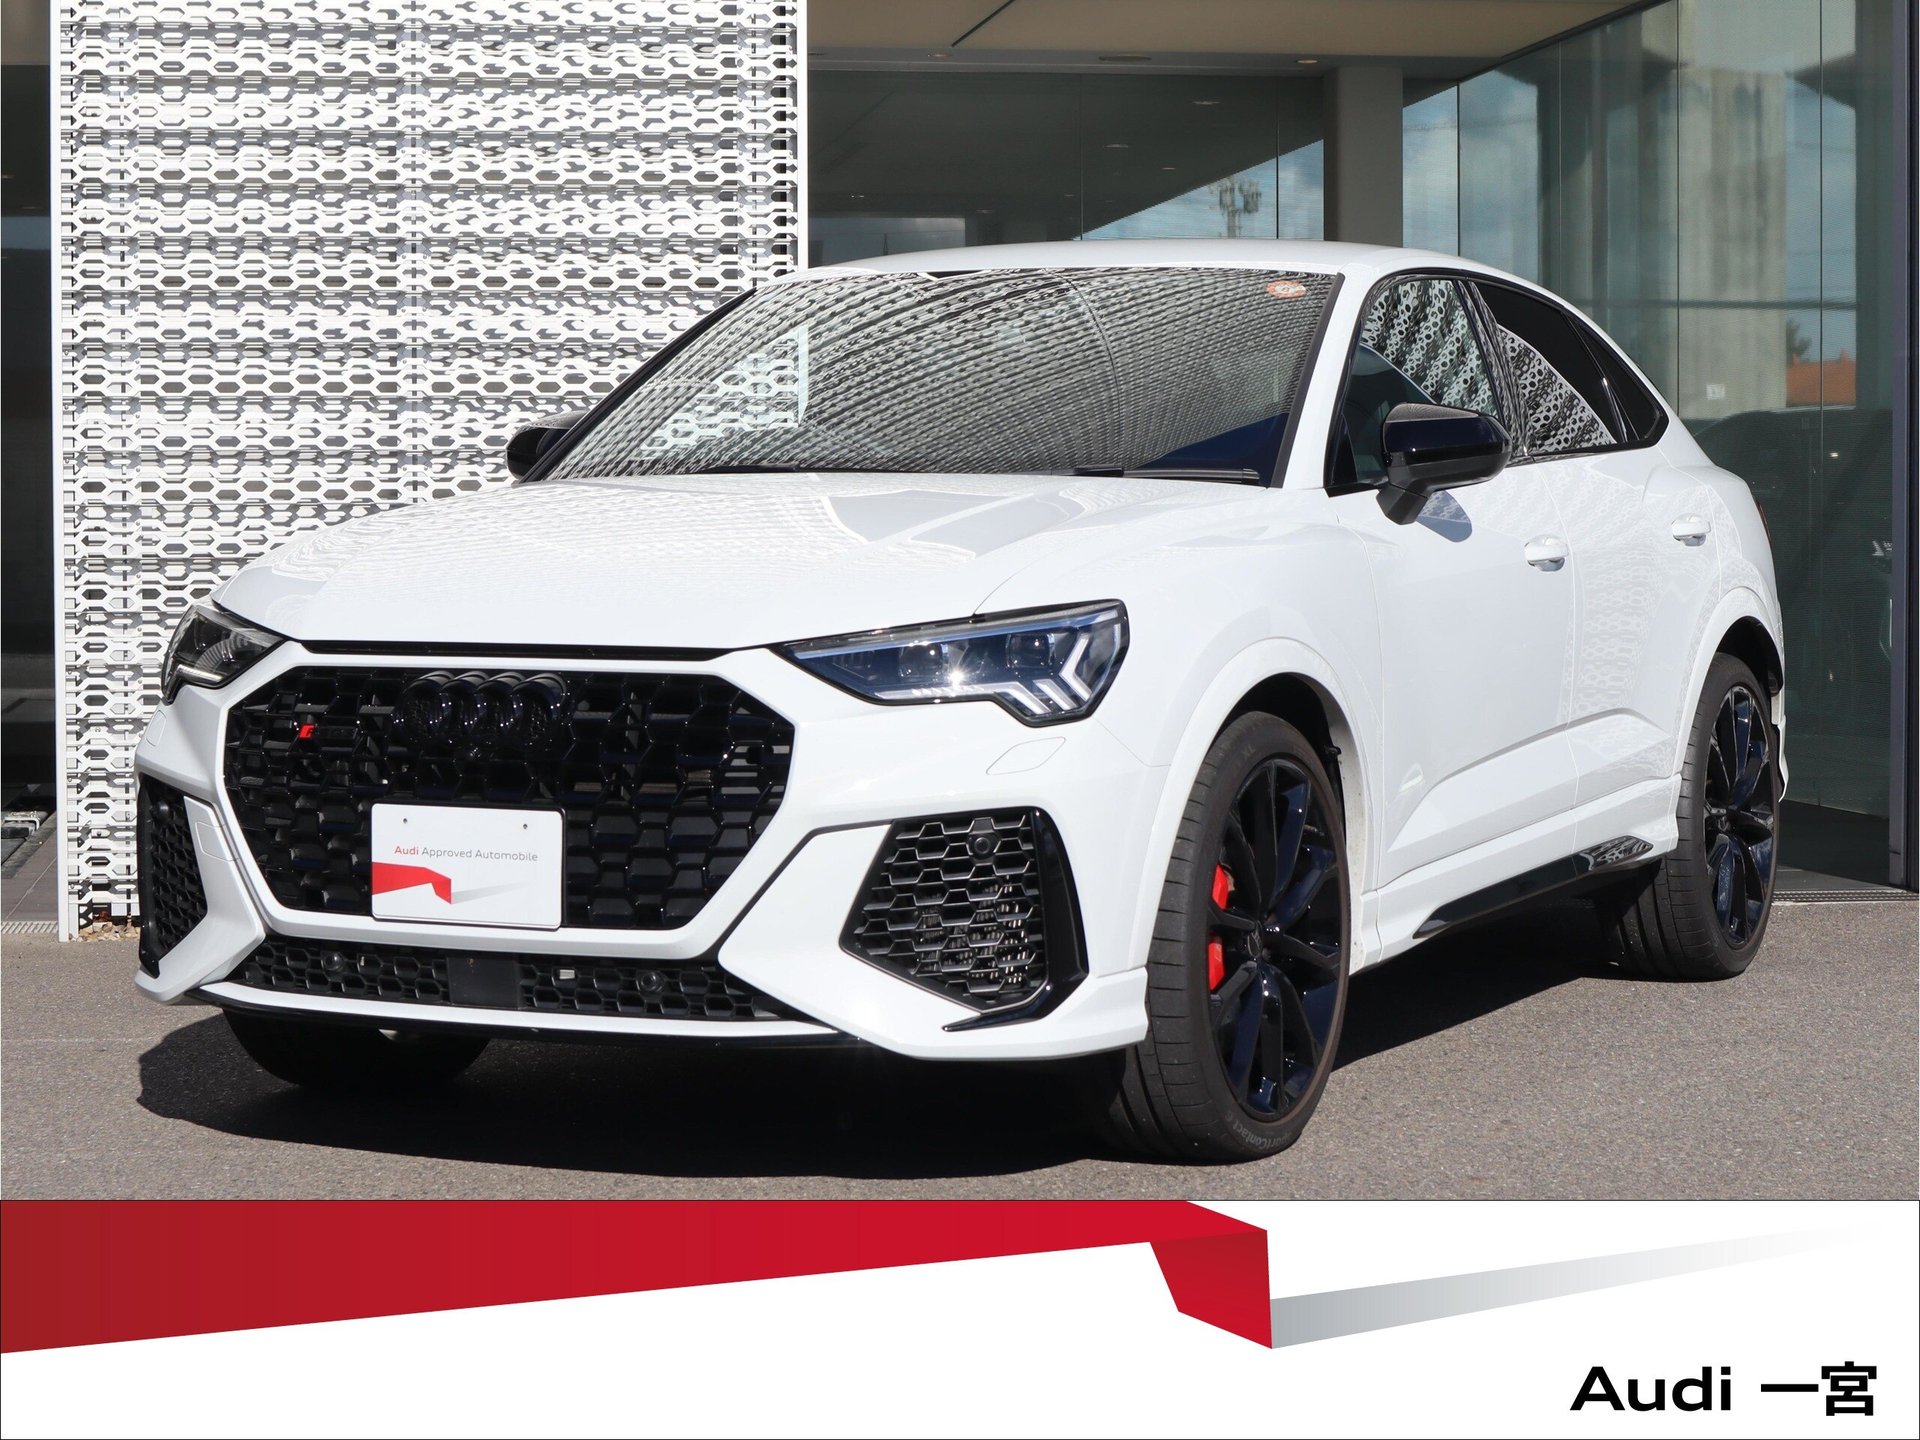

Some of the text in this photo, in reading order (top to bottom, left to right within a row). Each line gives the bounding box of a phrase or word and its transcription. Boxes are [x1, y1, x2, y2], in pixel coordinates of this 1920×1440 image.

[394, 845, 538, 862] Audi Approved Automobile
